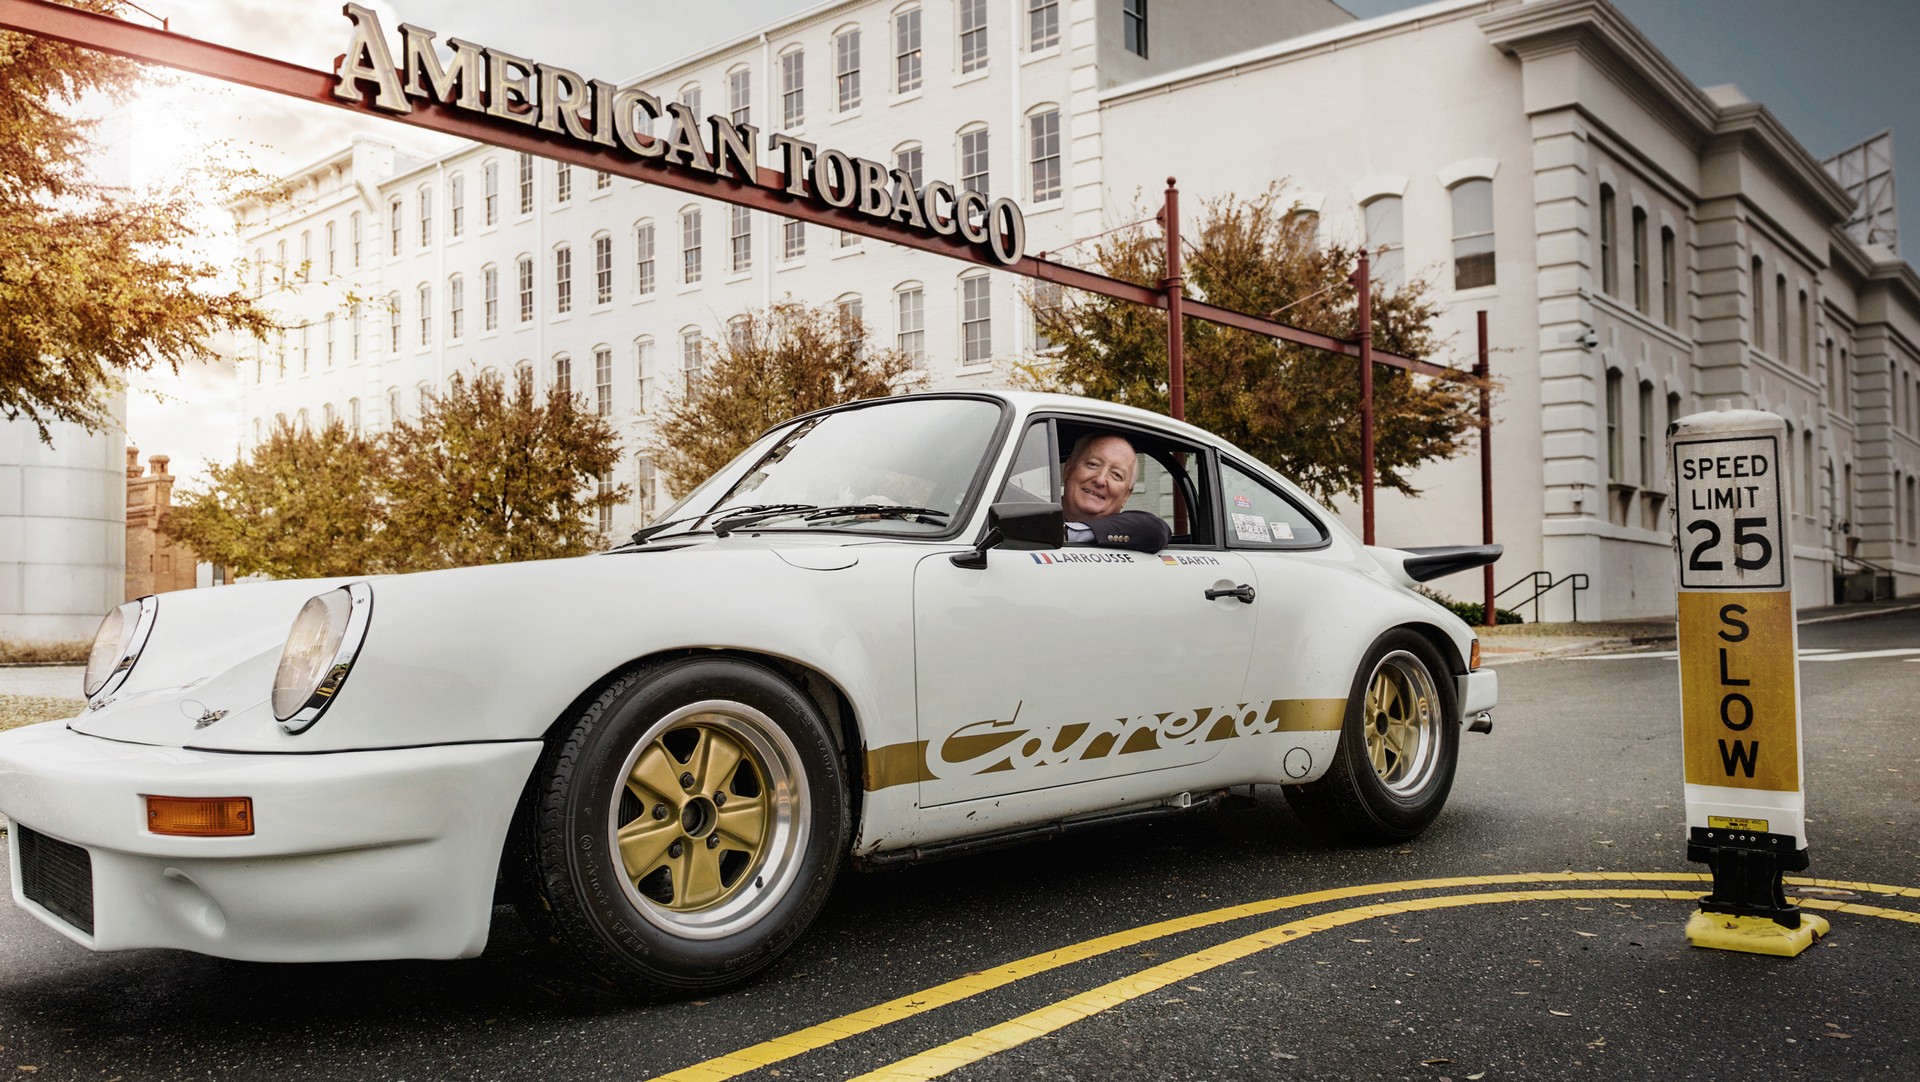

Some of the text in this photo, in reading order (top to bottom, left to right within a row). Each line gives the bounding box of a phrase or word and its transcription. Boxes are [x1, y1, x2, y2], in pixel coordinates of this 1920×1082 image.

[334, 1, 1026, 265] AMERICAN TOBACCO
[1683, 455, 1768, 480] SPEED
[1692, 486, 1759, 510] LIMIT
[1051, 553, 1134, 563] LARROUSSE
[1177, 555, 1220, 565] BARTH
[1687, 517, 1772, 571] 25
[1718, 604, 1759, 778] SLOW
[925, 700, 1280, 780] Carrera
